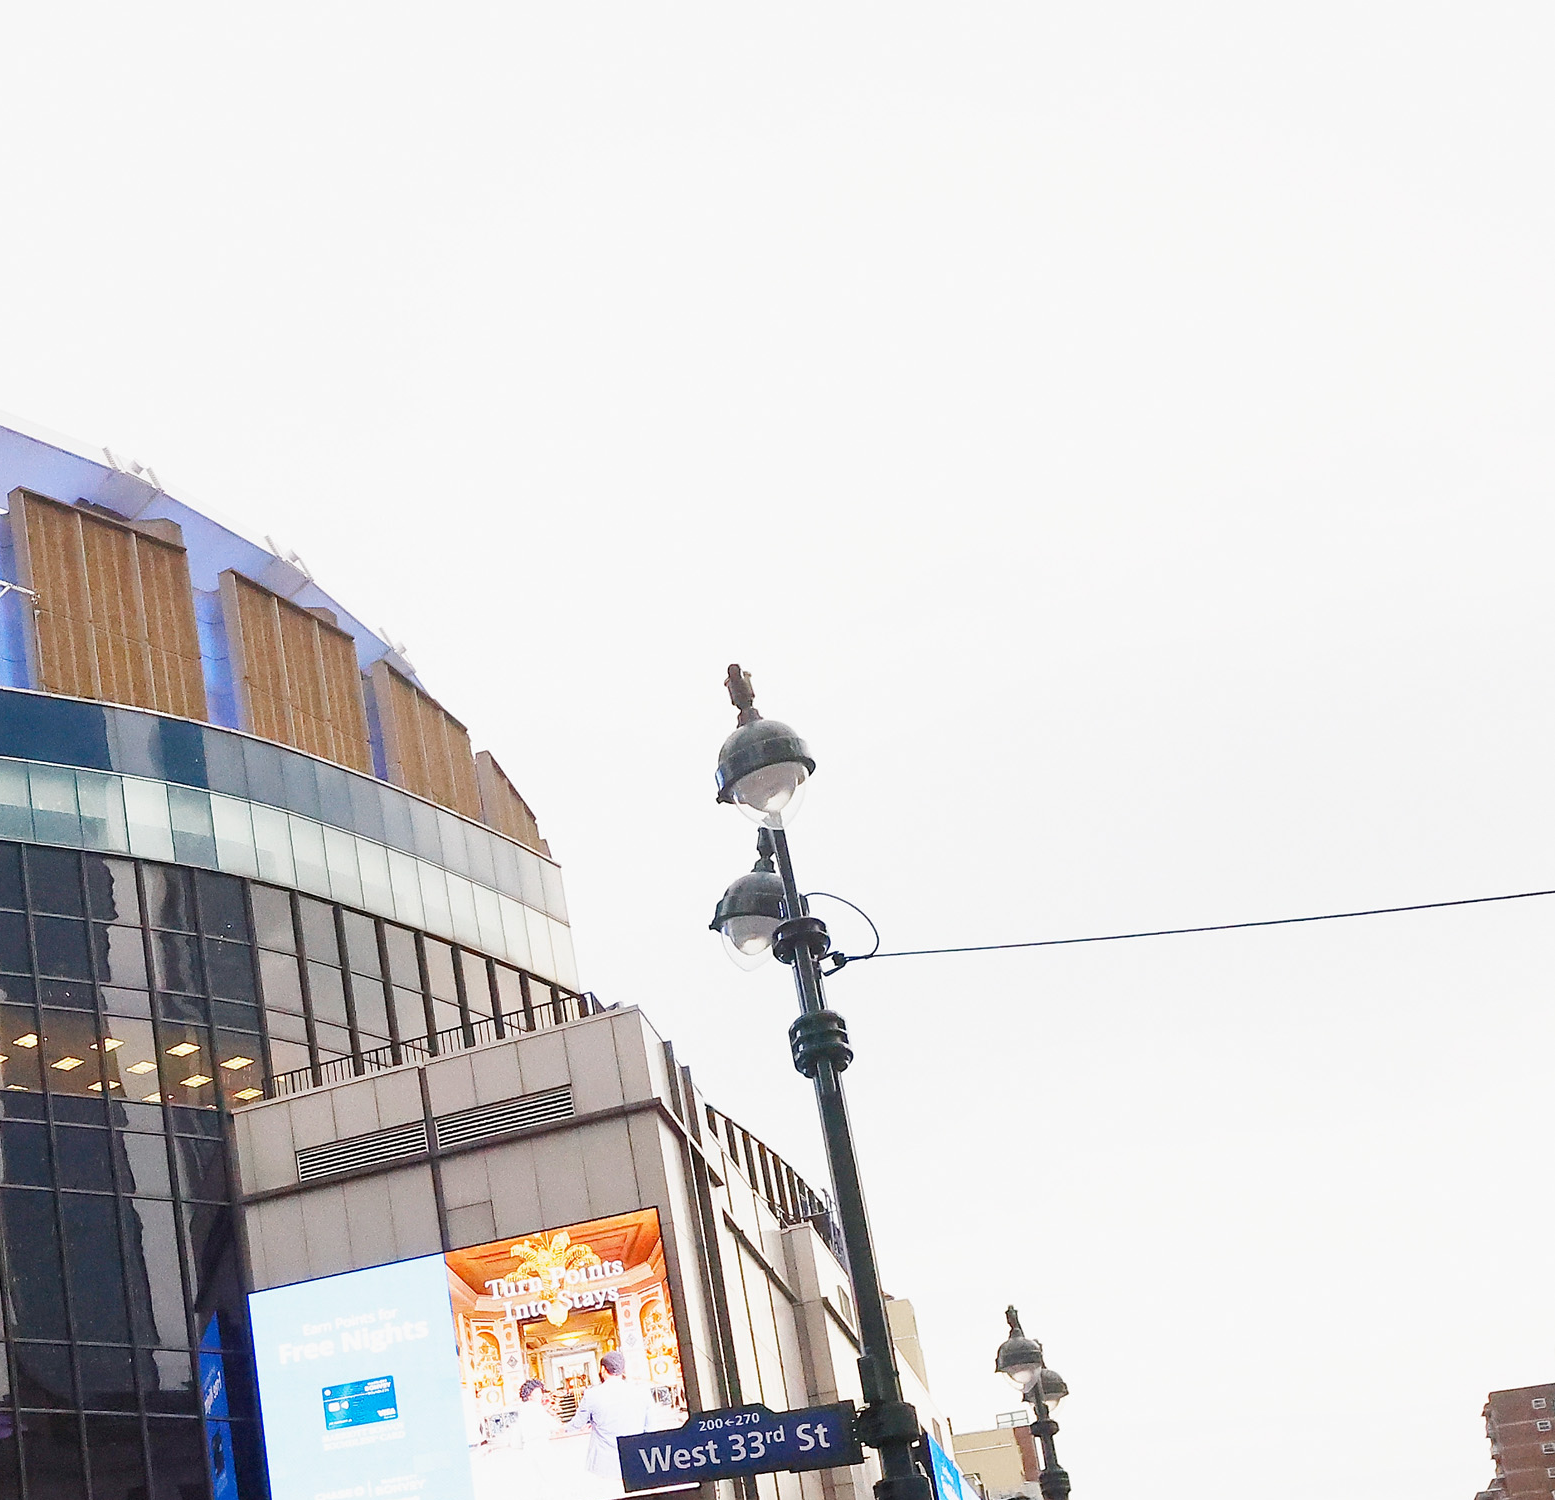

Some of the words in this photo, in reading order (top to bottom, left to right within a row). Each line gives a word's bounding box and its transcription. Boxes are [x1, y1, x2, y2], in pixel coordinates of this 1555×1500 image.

[484, 1277, 544, 1301] Turn
[548, 1259, 625, 1289] Points
[302, 1322, 333, 1337] Earn
[335, 1313, 376, 1329] Points
[377, 1307, 398, 1320] for
[502, 1299, 552, 1322] Into
[557, 1286, 620, 1309] Stays
[278, 1339, 335, 1365] Free
[340, 1319, 430, 1353] Nights
[698, 1418, 724, 1432] 200
[734, 1412, 760, 1426] 270
[637, 1439, 722, 1475] West
[727, 1424, 786, 1462] 33rd
[795, 1422, 831, 1452] St
